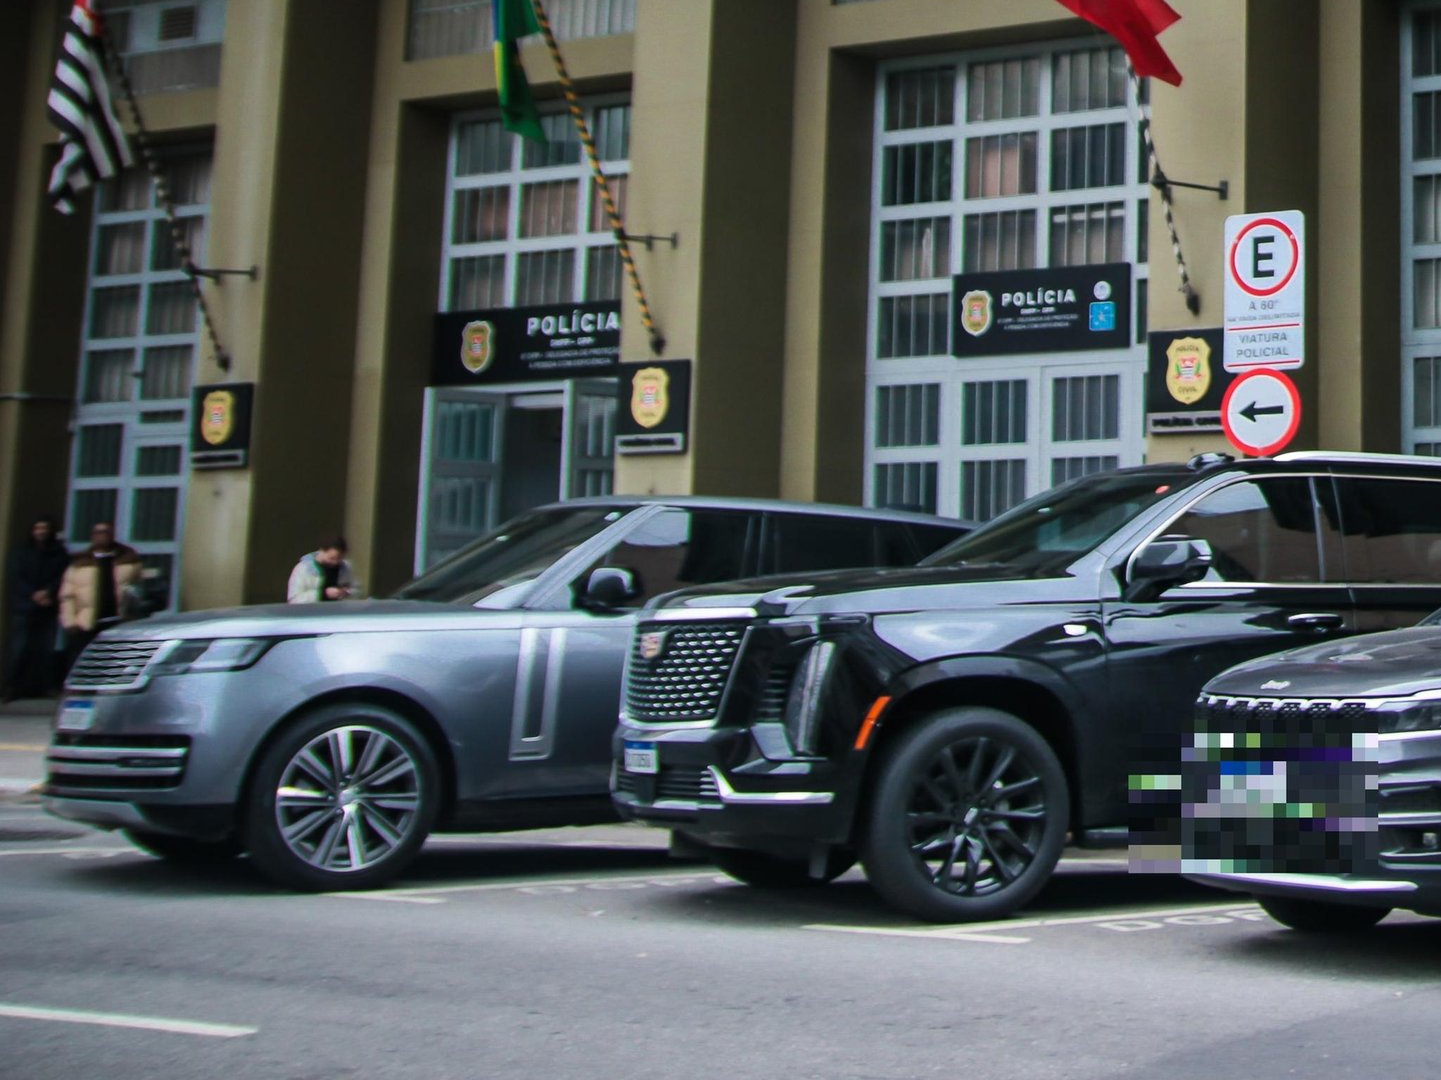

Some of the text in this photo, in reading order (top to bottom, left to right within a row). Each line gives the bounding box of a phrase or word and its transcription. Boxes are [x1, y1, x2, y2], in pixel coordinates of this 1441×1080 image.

[1252, 235, 1275, 278] E
[1002, 287, 1077, 307] POLÍCIA
[527, 309, 620, 336] POLÍCIA
[1239, 332, 1287, 344] VIATURA
[1236, 346, 1289, 359] POLICIAL
